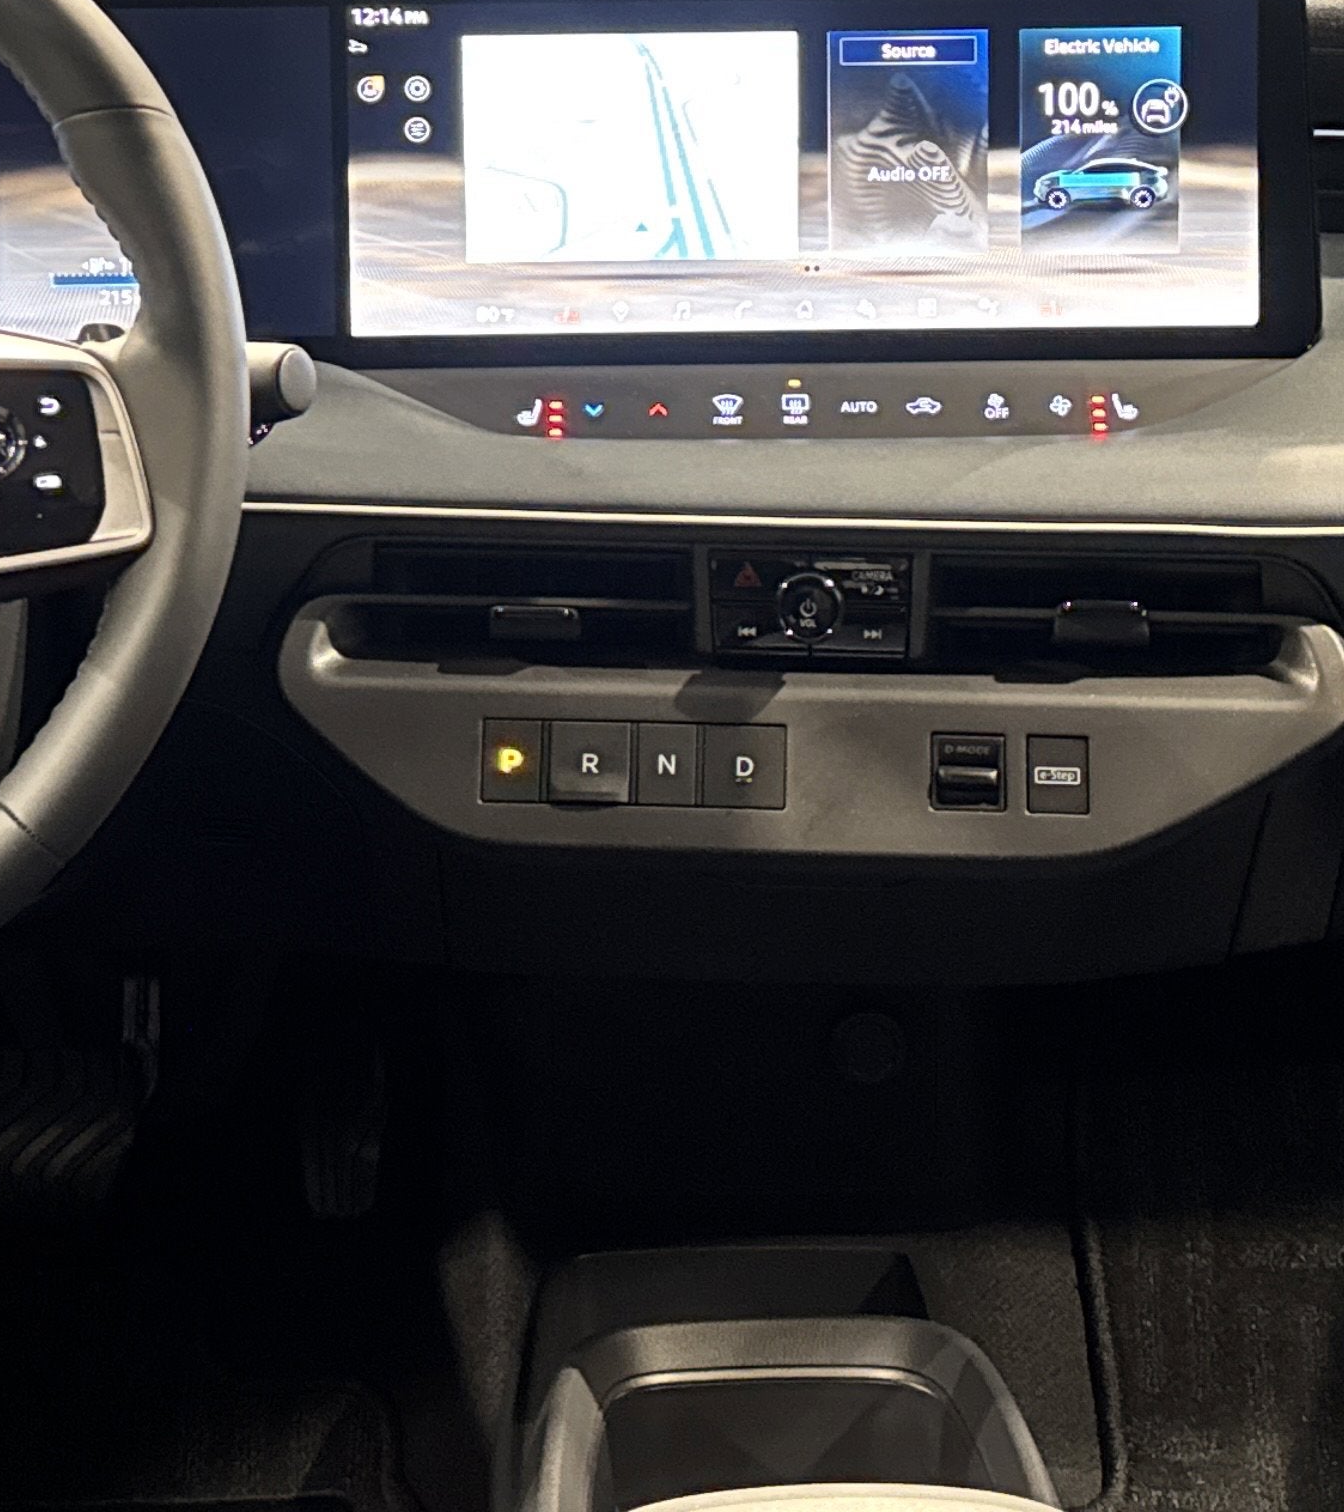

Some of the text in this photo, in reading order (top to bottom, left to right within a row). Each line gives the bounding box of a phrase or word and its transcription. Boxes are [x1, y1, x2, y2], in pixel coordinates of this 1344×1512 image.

[881, 43, 937, 59] Source
[1044, 38, 1160, 55] Electric Vehicle
[867, 165, 950, 183] Audio OFF
[840, 400, 877, 414] AUTO
[984, 406, 1009, 420] OFF
[713, 415, 743, 426] FRONT
[783, 415, 808, 425] REAR
[851, 571, 894, 582] CAMERA
[799, 618, 817, 628] VOL
[498, 746, 755, 777] P R N D
[1039, 769, 1076, 782] e-Step
